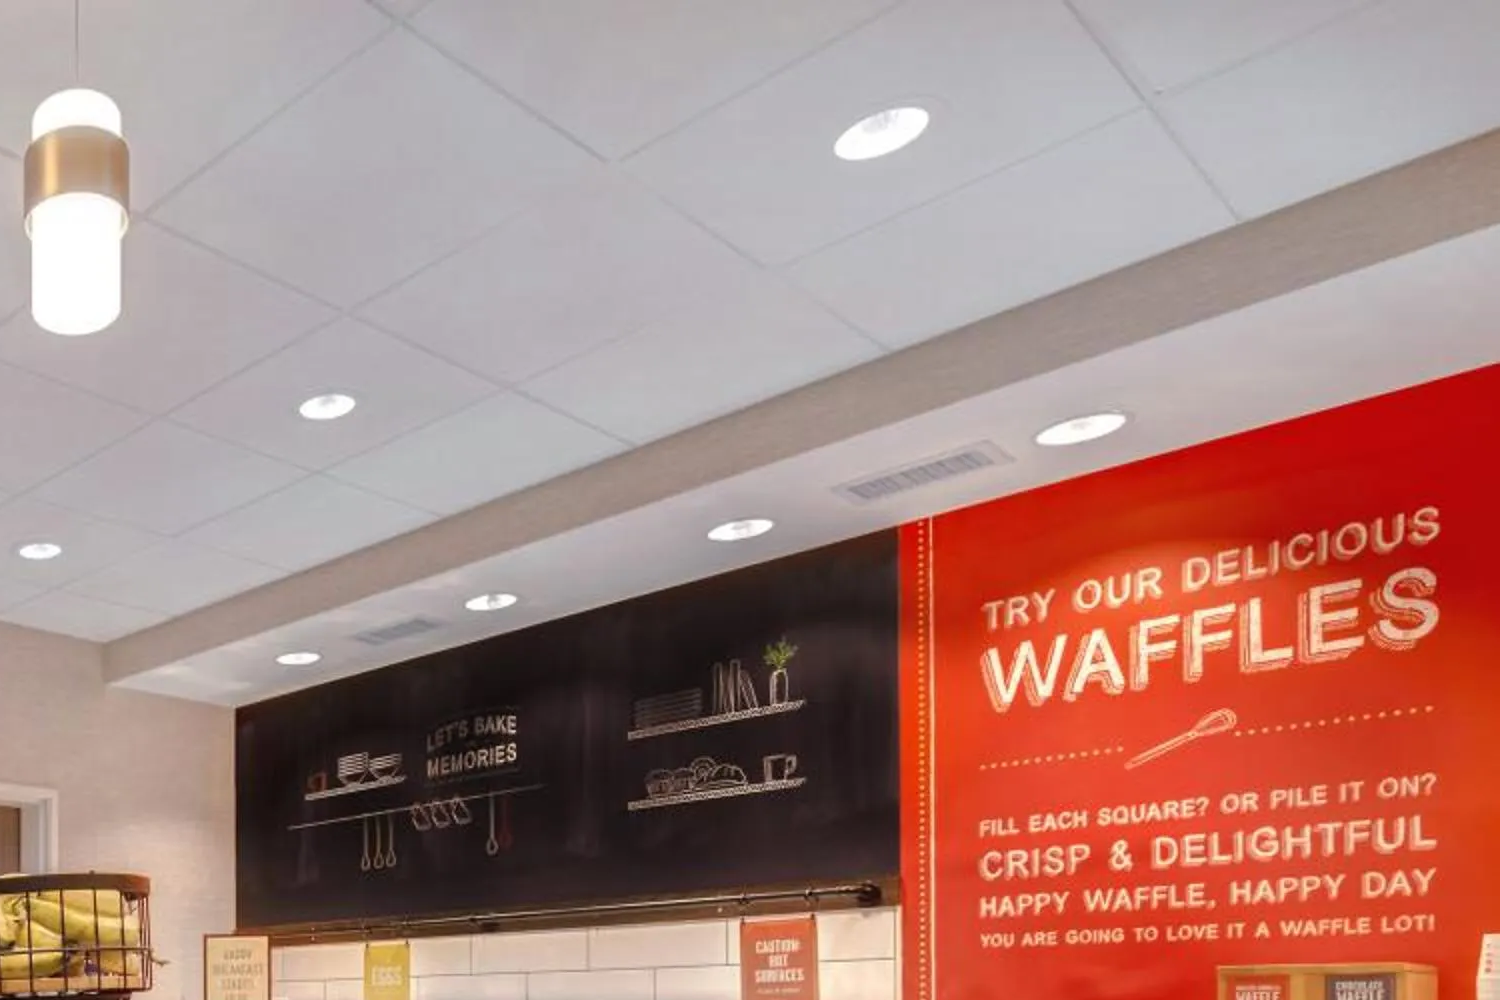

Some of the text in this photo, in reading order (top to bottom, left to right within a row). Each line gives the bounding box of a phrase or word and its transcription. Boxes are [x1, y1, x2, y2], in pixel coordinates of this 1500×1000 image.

[981, 506, 1442, 630] TRY OUR DELICIOUS
[979, 566, 1441, 714] WAFFLES
[426, 714, 517, 754] LET'S BAKE
[426, 742, 517, 779] MEMORIES
[979, 772, 1438, 838] FILL EACH SQUARE? OR PILE IT ON?
[979, 814, 1438, 882] CRISP & DELIGHTFUL
[979, 866, 1437, 919] HAPPY WAFFLE, HAPPY DAY
[980, 914, 1436, 949] YOU ARE GOING TO LOVE IT A WAFFLE LOT!
[755, 967, 805, 983] SURFACES
